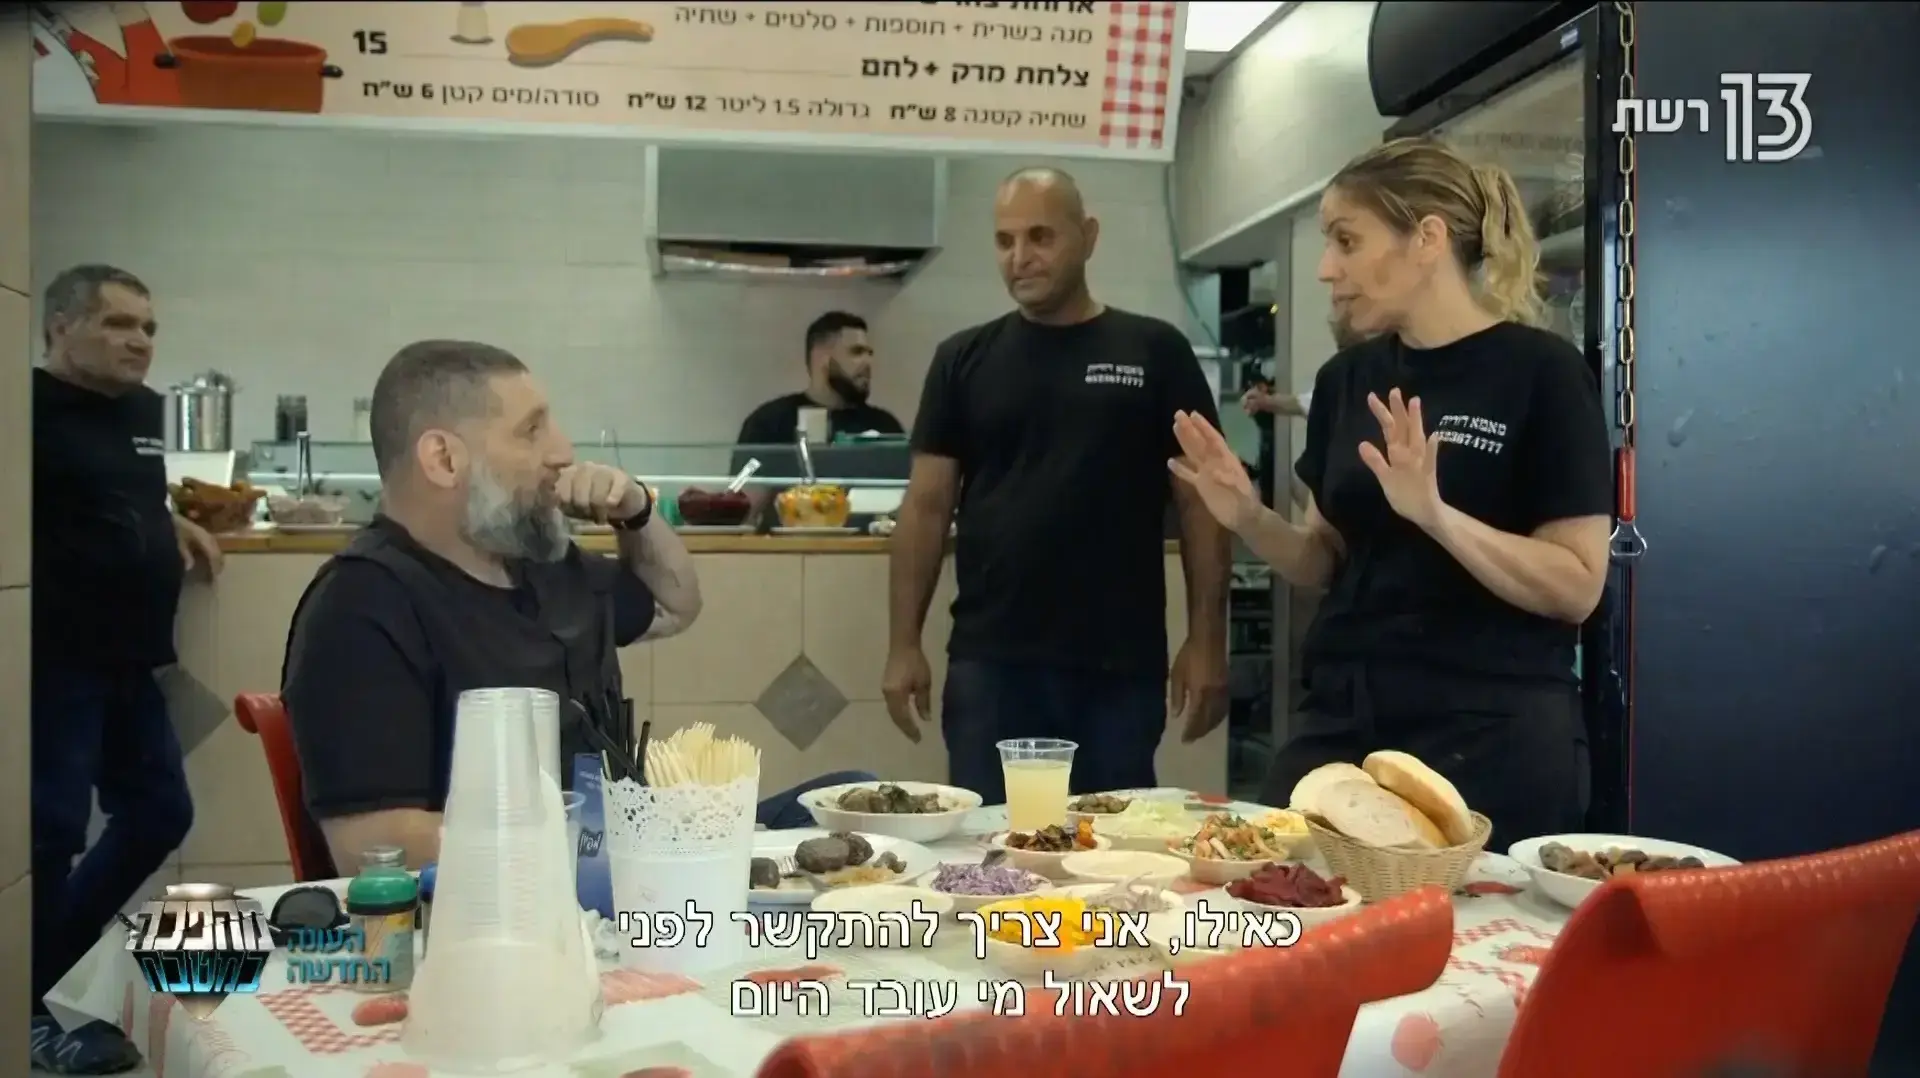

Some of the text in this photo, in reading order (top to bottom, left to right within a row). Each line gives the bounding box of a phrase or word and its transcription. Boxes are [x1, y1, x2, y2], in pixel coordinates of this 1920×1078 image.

[675, 6, 737, 25] שתיה
[765, 9, 837, 30] סלטים
[865, 17, 946, 36] תוספות
[973, 22, 1043, 42] בשרית
[1050, 28, 1092, 44] מנה
[352, 30, 388, 54] 15
[951, 62, 1005, 84] מרק
[1015, 63, 1089, 87] צלחת
[421, 83, 434, 99] 6
[442, 84, 484, 104] קטן
[684, 95, 708, 111] 12
[716, 93, 767, 113] ליטר
[808, 98, 870, 118] גדולה
[944, 106, 957, 122] 8
[963, 107, 1022, 127] קטנה
[1028, 110, 1086, 128] שתיה
[1469, 416, 1507, 436] מאמא
